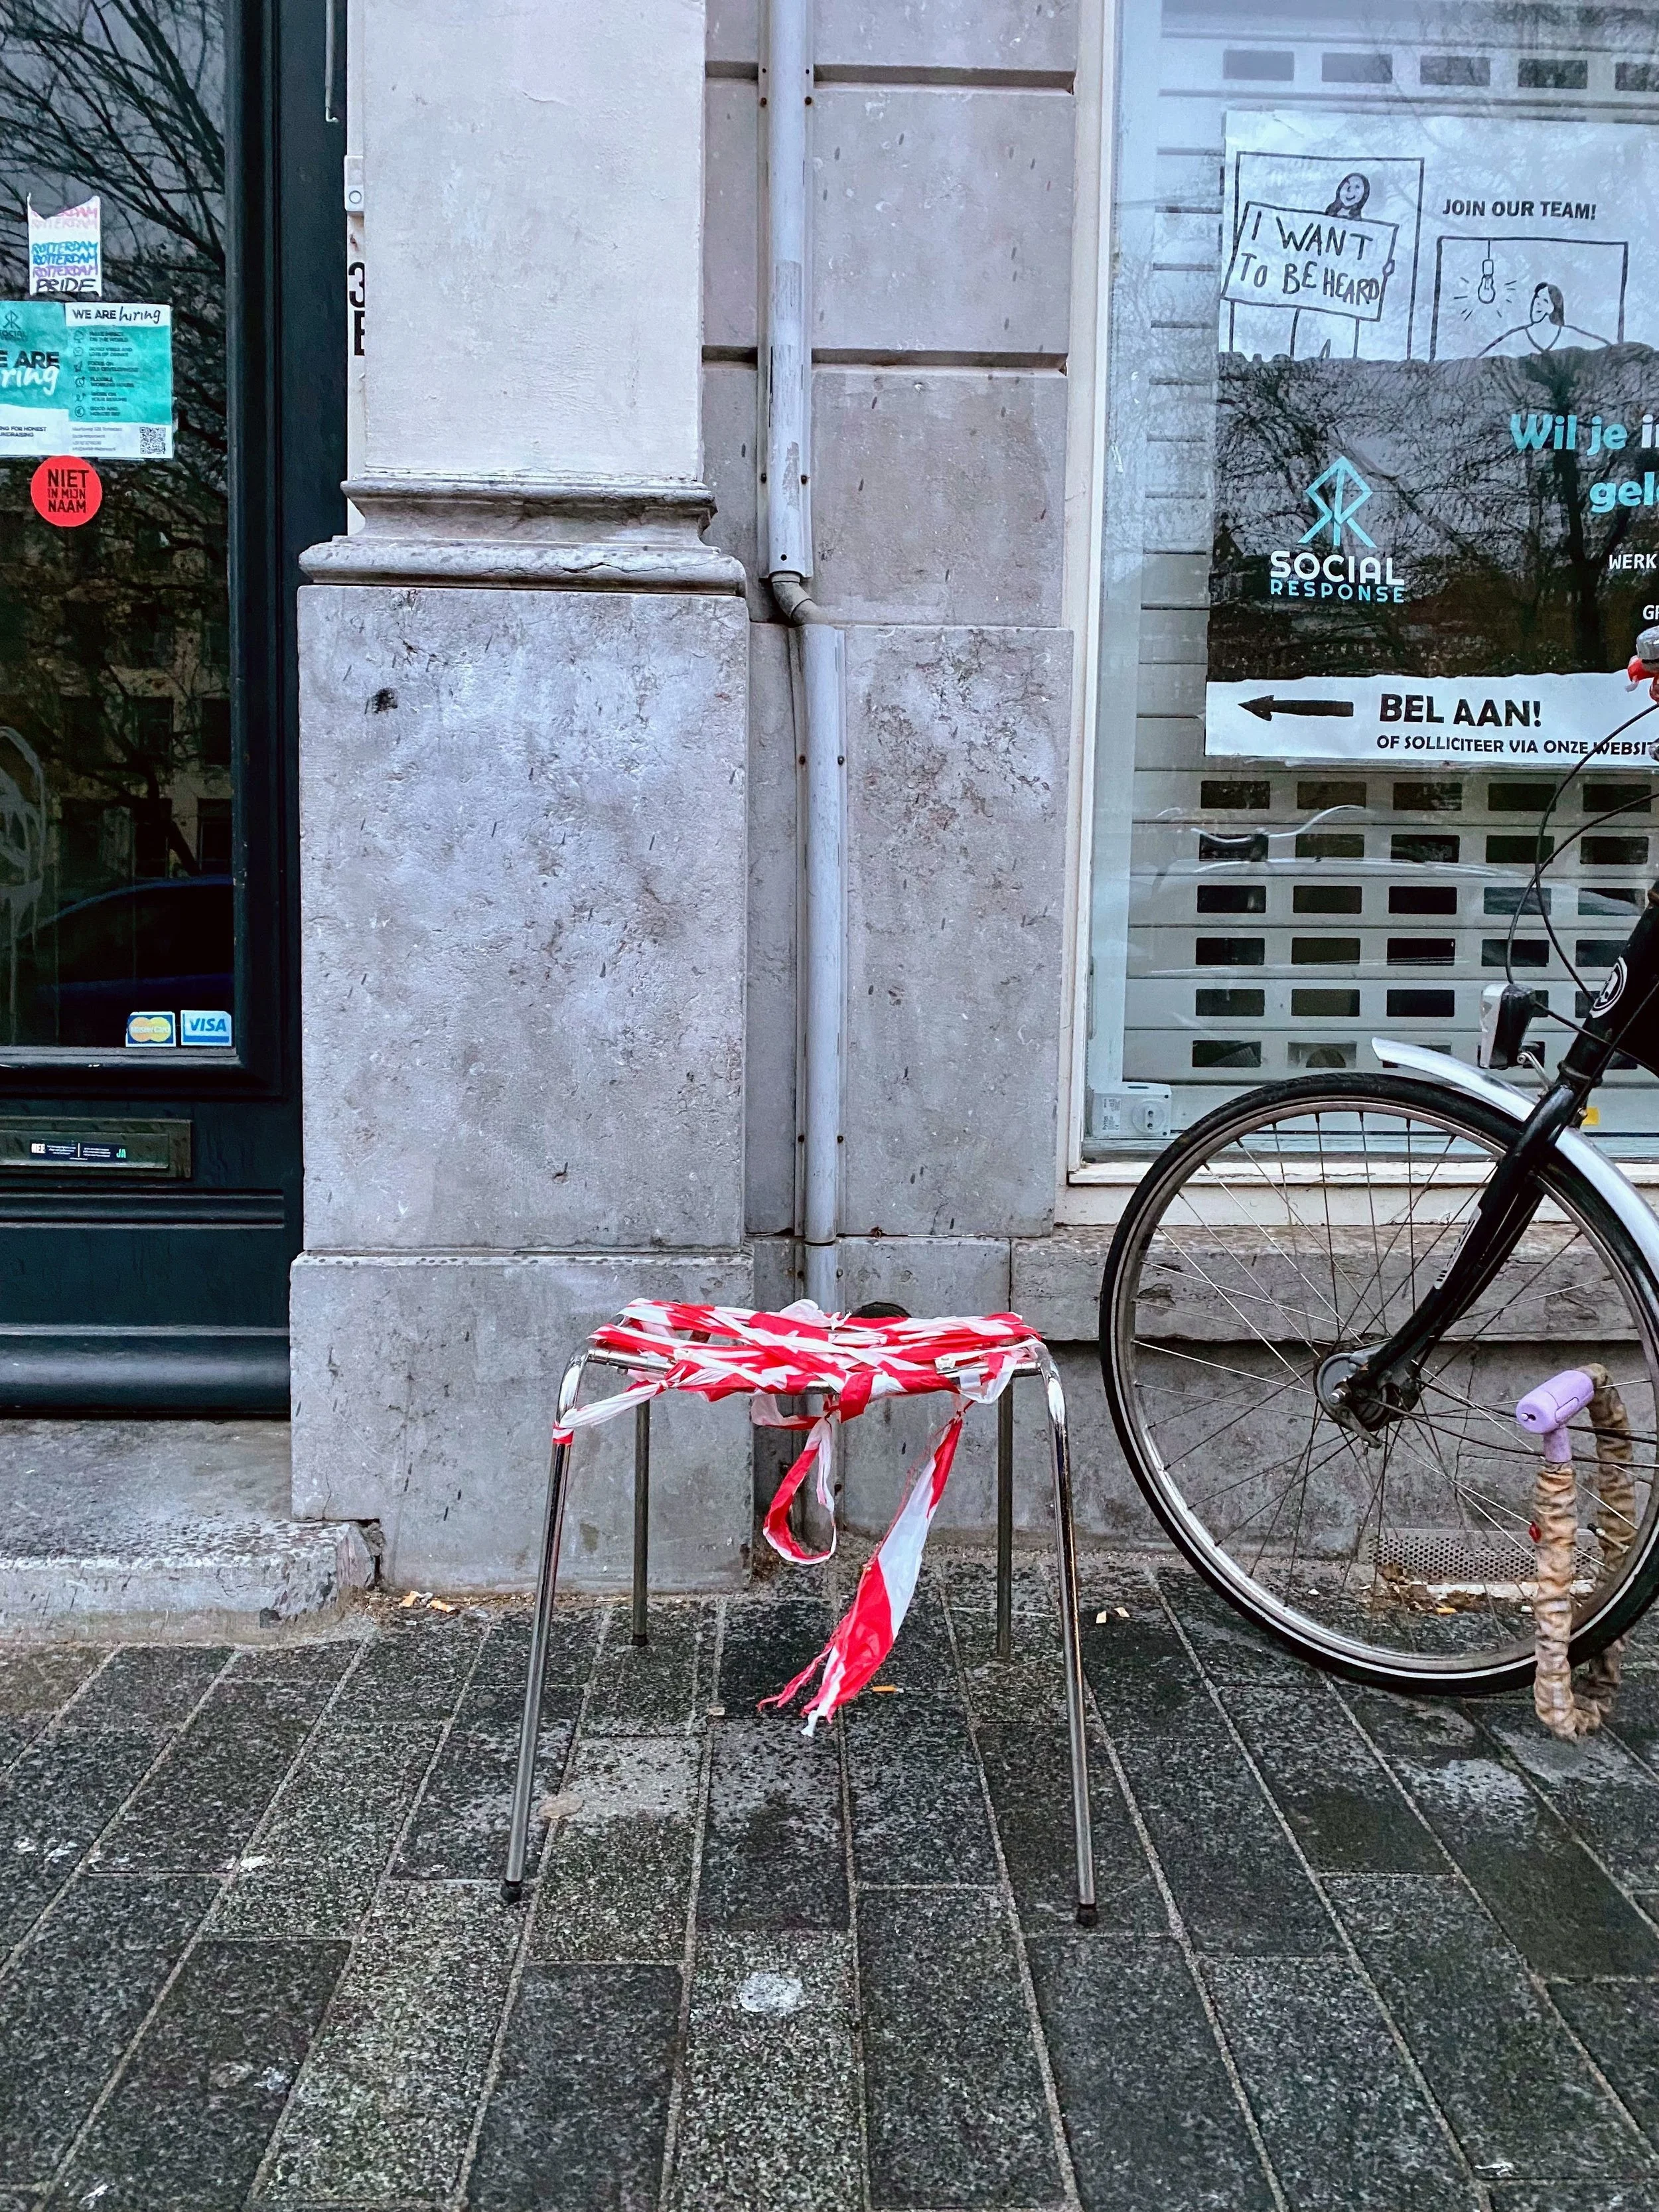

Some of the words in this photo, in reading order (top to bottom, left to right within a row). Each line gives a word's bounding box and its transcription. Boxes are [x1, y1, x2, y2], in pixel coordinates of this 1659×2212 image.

[1443, 199, 1485, 216] JOIN
[1492, 200, 1534, 217] OUR
[1540, 201, 1597, 220] TEAM!
[1252, 211, 1262, 240] I
[1275, 216, 1373, 260] WANT
[32, 241, 98, 254] ROTTERDAM
[33, 252, 98, 265] ROTTERDAM
[33, 265, 98, 277] ROTTERDAM
[1241, 252, 1268, 287] TO
[1282, 261, 1317, 294] BE
[1323, 267, 1380, 305] HEARD
[72, 309, 91, 319] WE
[95, 310, 116, 319] ARE
[119, 306, 161, 324] hiring
[0, 350, 8, 368] E
[14, 350, 60, 369] ARE
[0, 366, 59, 396] ring
[1510, 413, 1577, 450] Wil
[1587, 415, 1628, 456] je
[1641, 413, 1659, 449] i
[47, 469, 90, 488] NIET
[48, 488, 58, 499] IN
[61, 488, 86, 500] MIJN
[1589, 471, 1659, 513] gel
[48, 499, 86, 514] NAAM
[1270, 550, 1405, 585] SOCIAL
[1609, 553, 1657, 569] WERK
[1270, 579, 1405, 603] RESPONSE
[1380, 694, 1445, 723] BEL
[1453, 698, 1542, 727] AAN!
[1376, 735, 1400, 749] OF
[1404, 735, 1504, 753] SOLLICITEER
[1509, 739, 1539, 754] VIA
[1544, 740, 1589, 755] ONZE
[190, 1017, 226, 1032] VISA
